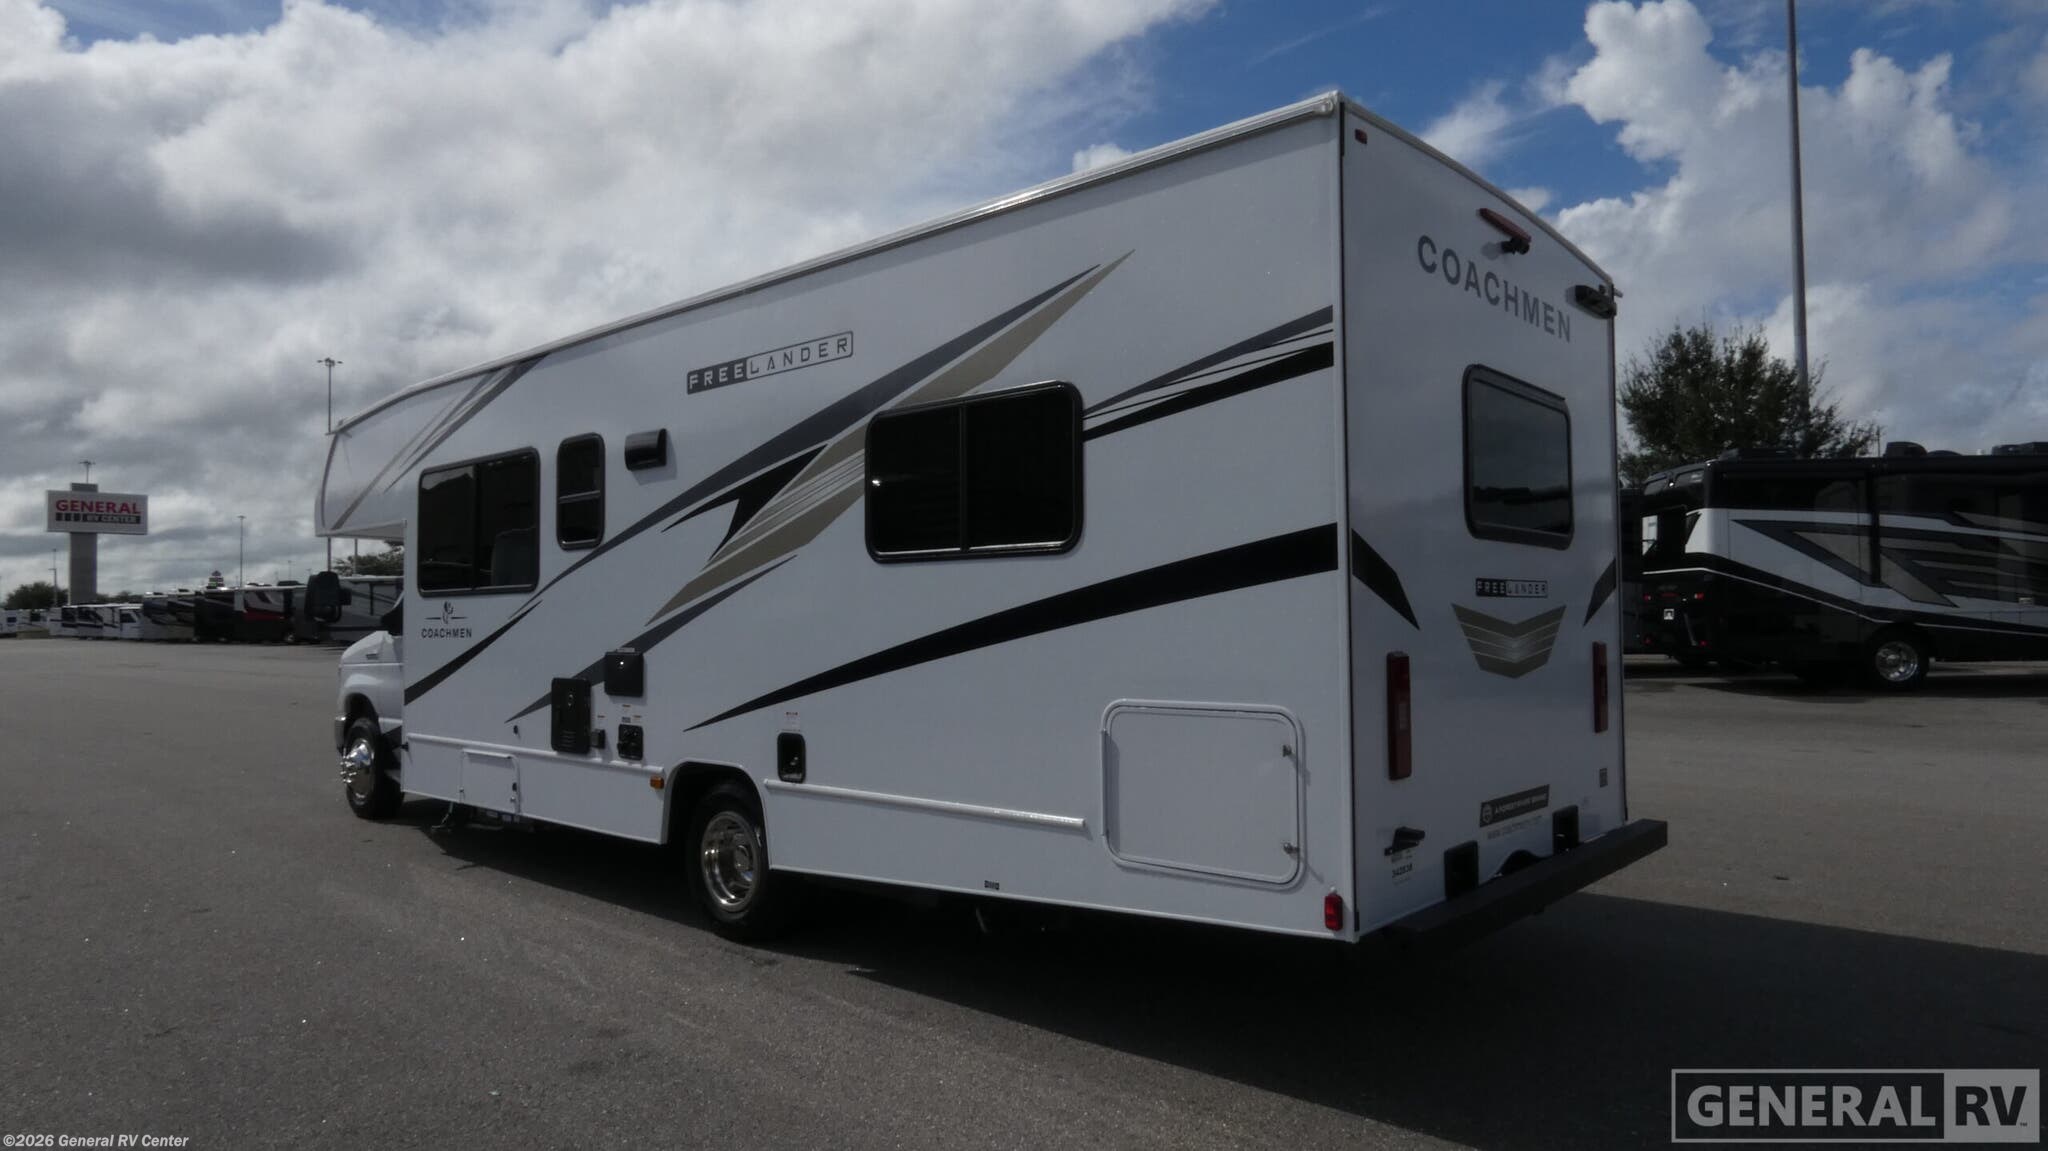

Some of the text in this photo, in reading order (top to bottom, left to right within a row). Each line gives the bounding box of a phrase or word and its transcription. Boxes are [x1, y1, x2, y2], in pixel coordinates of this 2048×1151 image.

[1417, 235, 1571, 343] COACHMEN
[689, 337, 848, 390] FREELANDER
[55, 500, 141, 514] GENERAL
[1477, 580, 1546, 594] FREELANDER
[421, 627, 472, 639] COACHMEN
